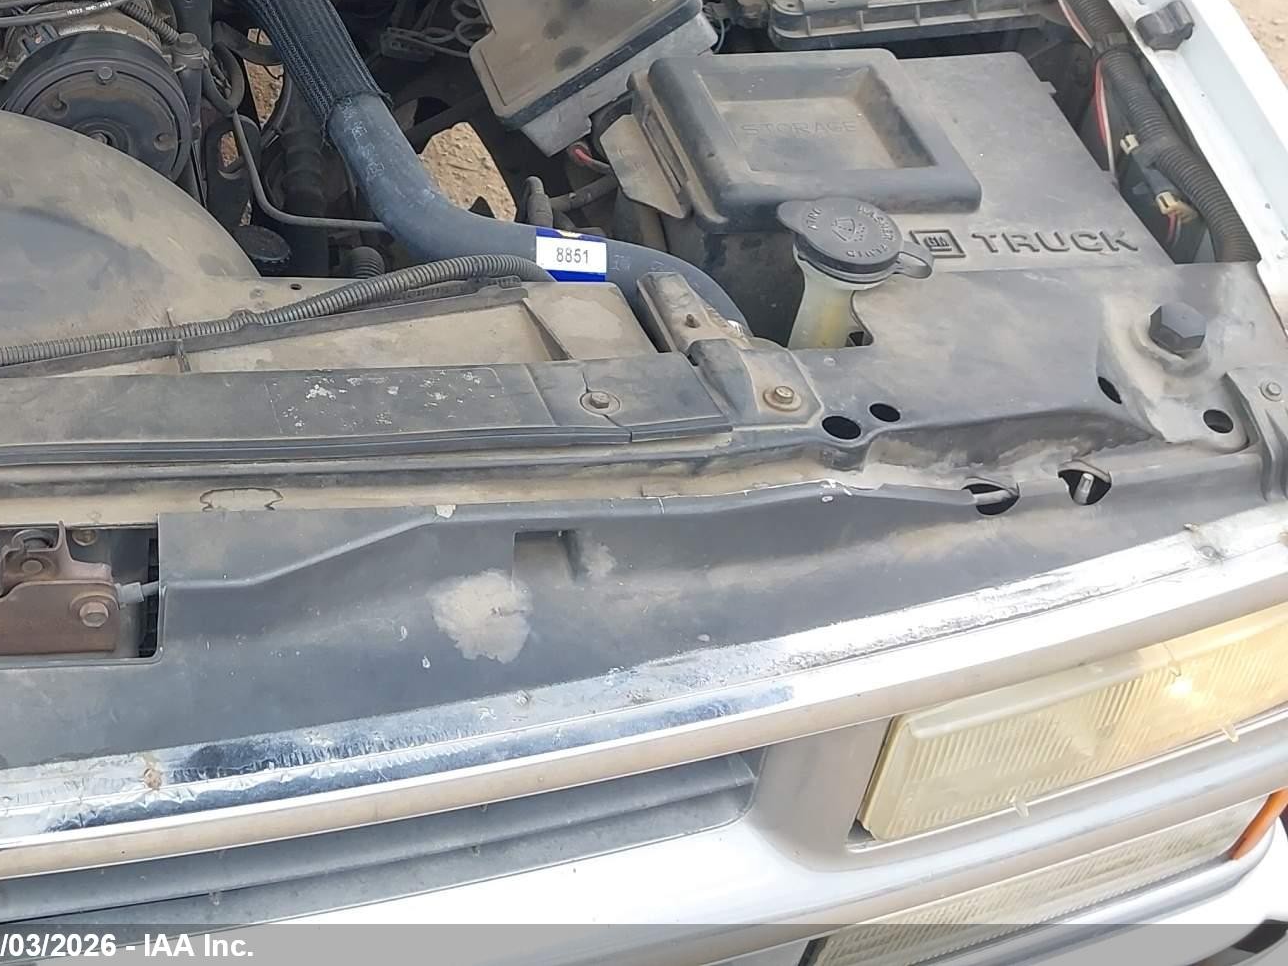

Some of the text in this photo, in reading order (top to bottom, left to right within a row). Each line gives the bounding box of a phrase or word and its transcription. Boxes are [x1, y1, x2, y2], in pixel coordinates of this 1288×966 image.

[740, 121, 858, 136] STORAGE
[971, 232, 1139, 253] TRUCK
[555, 246, 590, 265] 8851
